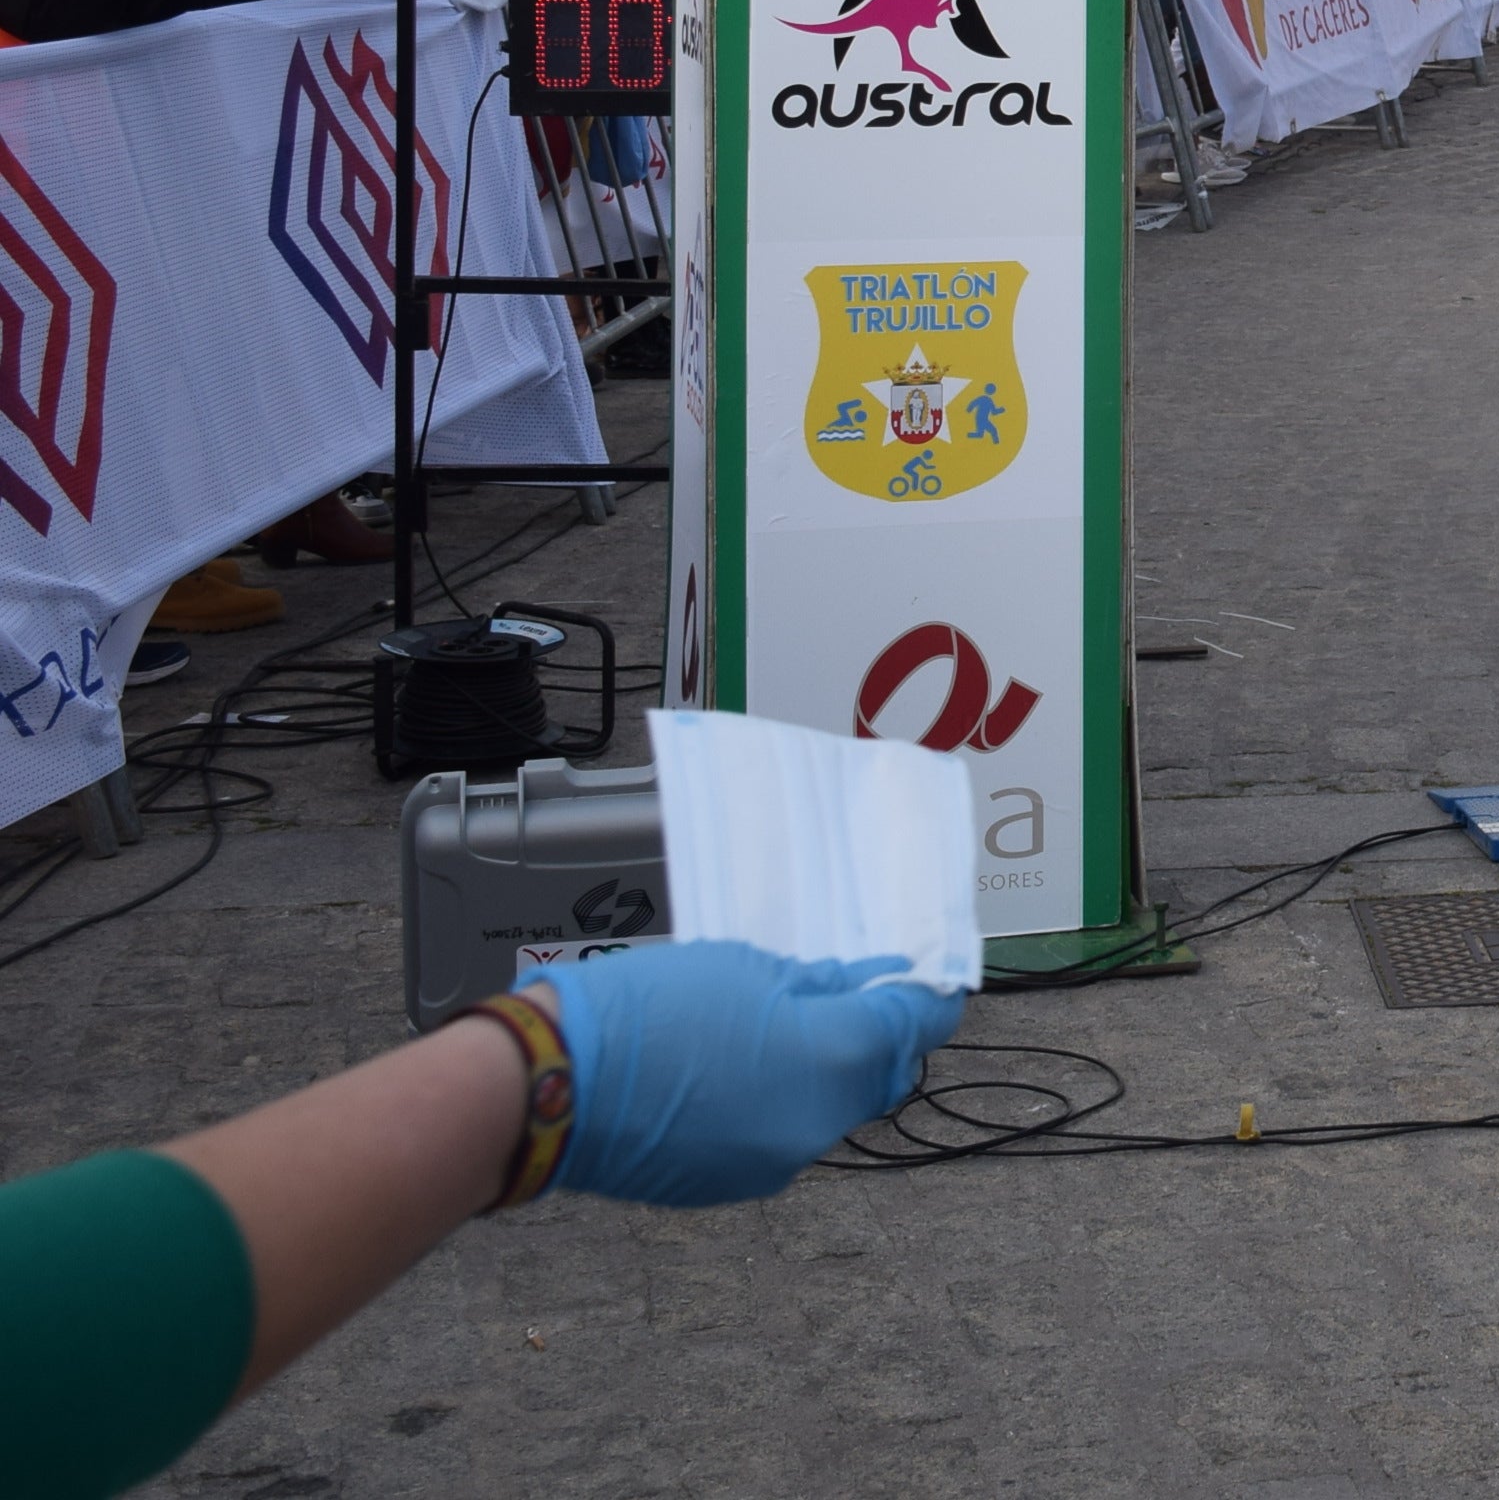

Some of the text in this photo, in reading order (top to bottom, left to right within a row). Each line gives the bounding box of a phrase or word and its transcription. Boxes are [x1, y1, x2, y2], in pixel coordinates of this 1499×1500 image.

[1279, 9, 1304, 51] DE
[771, 81, 1074, 130] austral
[840, 267, 996, 304] TRIATLÓN
[845, 303, 992, 334] TRUJILLO
[977, 871, 1045, 892] SORES
